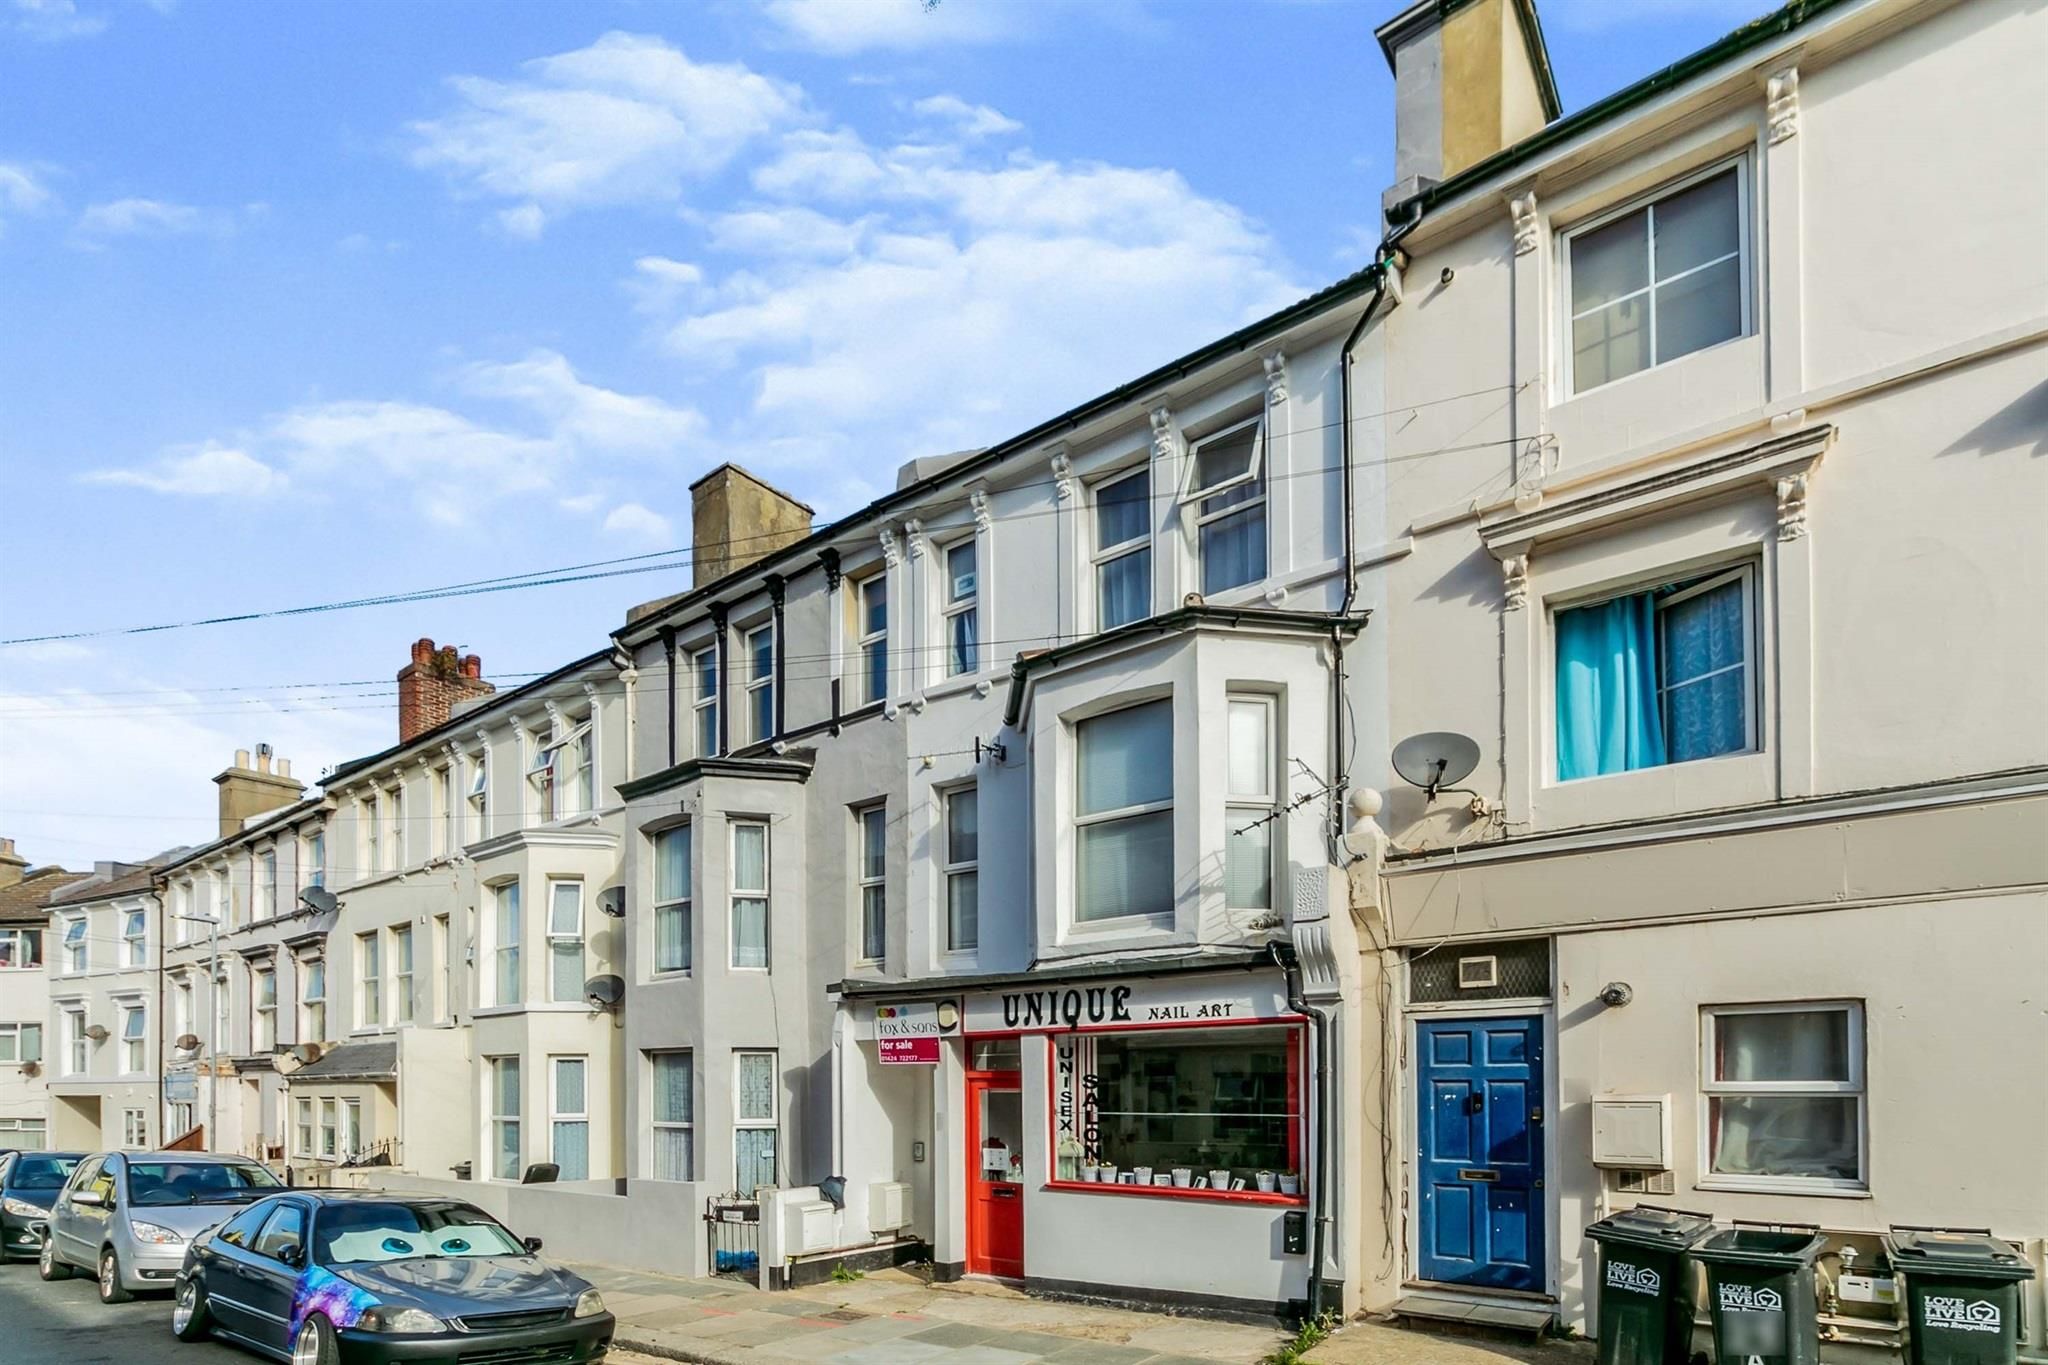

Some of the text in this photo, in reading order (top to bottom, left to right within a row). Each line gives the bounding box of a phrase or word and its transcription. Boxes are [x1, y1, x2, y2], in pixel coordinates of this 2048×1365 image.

[1002, 985, 1233, 1030] UNIQUE NAIL ART
[880, 1019, 938, 1035] fox & sons
[881, 1040, 913, 1050] for sale
[1060, 1047, 1073, 1131] UNISEX
[1082, 1074, 1102, 1160] SALON
[1607, 1260, 1635, 1271] LOVE
[1607, 1271, 1636, 1283] LIVE
[1718, 1282, 1752, 1293] LOVE
[1720, 1293, 1753, 1305] LIVE
[1924, 1296, 1965, 1307] LOVE
[1924, 1307, 1966, 1320] LIVE
